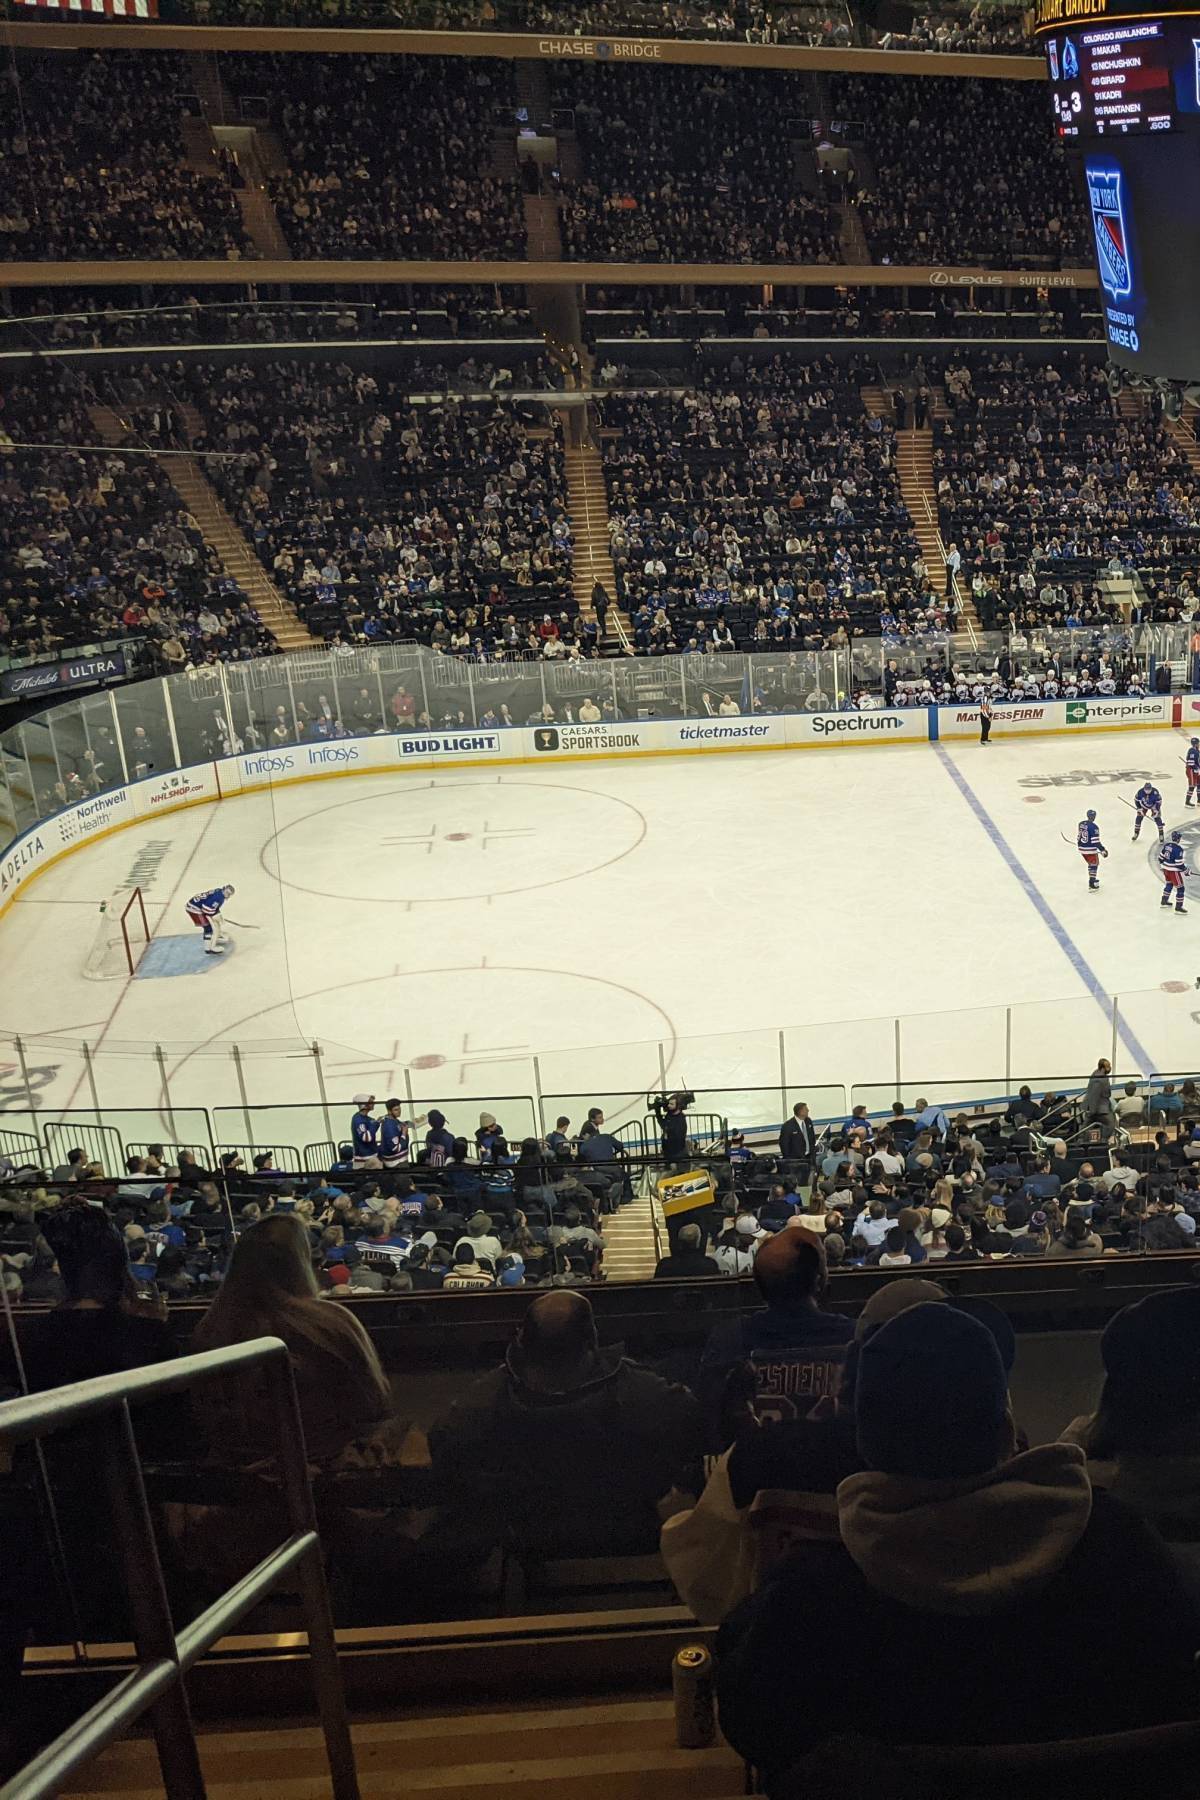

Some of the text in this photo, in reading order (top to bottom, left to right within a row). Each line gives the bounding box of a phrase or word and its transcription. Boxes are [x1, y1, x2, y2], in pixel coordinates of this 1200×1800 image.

[1084, 26, 1158, 44] COLORADO AVALANCHE
[540, 41, 661, 57] CHASE BRIDGE
[1096, 45, 1121, 55] MAKAR
[1098, 57, 1141, 70] NICHUSHKIN
[1100, 75, 1126, 85] GIRARD
[1071, 91, 1081, 112] 3
[1101, 90, 1122, 100] KADRI
[1103, 104, 1141, 115] RANTANEN
[1100, 188, 1118, 208] YORK
[1097, 215, 1128, 283] RANGERS
[950, 276, 1076, 286] LEXUS SUITE LEVEL
[11, 660, 117, 692] Michelob ULTRA
[956, 708, 1044, 722] MATESSFIRM
[1072, 703, 1162, 721] enterprise
[561, 726, 608, 736] CAESARS
[680, 724, 770, 740] ticketmaster
[812, 716, 898, 735] Spectrum
[402, 736, 496, 753] BUD LIGHT
[561, 734, 640, 750] SPORTSBOOK
[308, 746, 359, 765] Infosys
[244, 755, 294, 776] Infosys
[150, 784, 204, 804] NHLSHOP.com
[77, 791, 127, 818] Northwell
[79, 812, 111, 833] Health
[7, 836, 45, 880] DELTA
